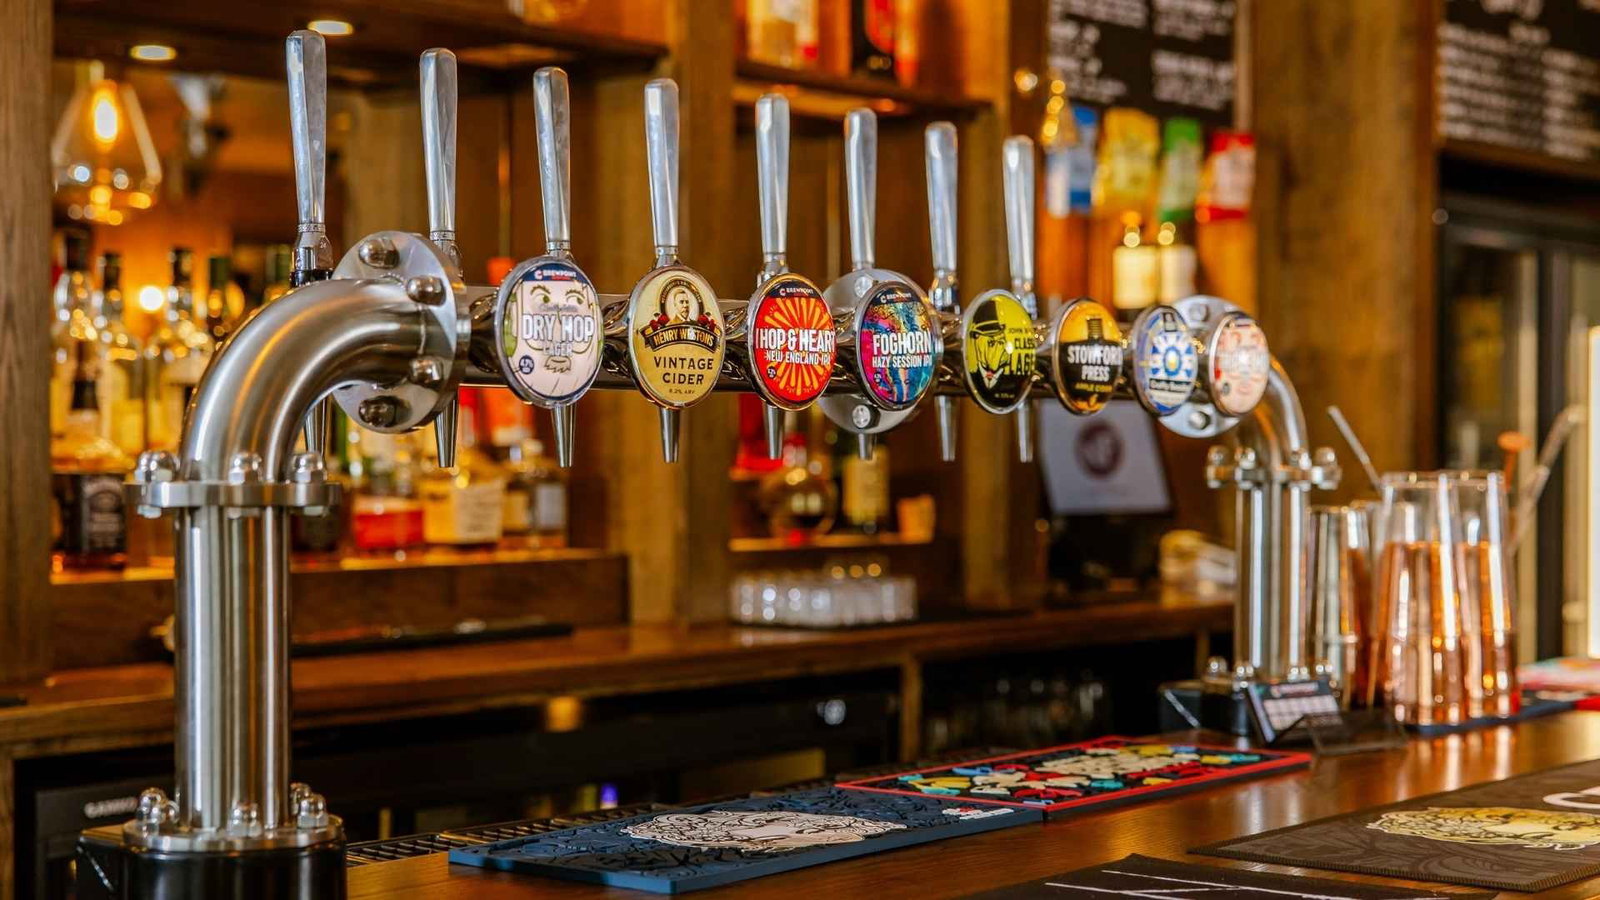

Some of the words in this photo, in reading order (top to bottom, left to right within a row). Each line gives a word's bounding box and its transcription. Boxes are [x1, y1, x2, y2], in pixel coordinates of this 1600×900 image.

[522, 314, 556, 341] DRY
[561, 315, 595, 343] HOP
[653, 328, 678, 346] HENRY
[760, 328, 786, 350] HOP
[787, 329, 797, 351] &
[799, 329, 836, 352] HEART
[872, 329, 932, 355] FOGHORN
[543, 341, 574, 357] LAGER
[654, 356, 714, 370] VINTAGE
[766, 350, 783, 362] NEW
[785, 352, 819, 365] ENGLAND
[872, 354, 890, 368] HAZY
[892, 354, 922, 368] SESSION
[662, 372, 704, 385] CIDER
[1081, 365, 1110, 382] PRESS
